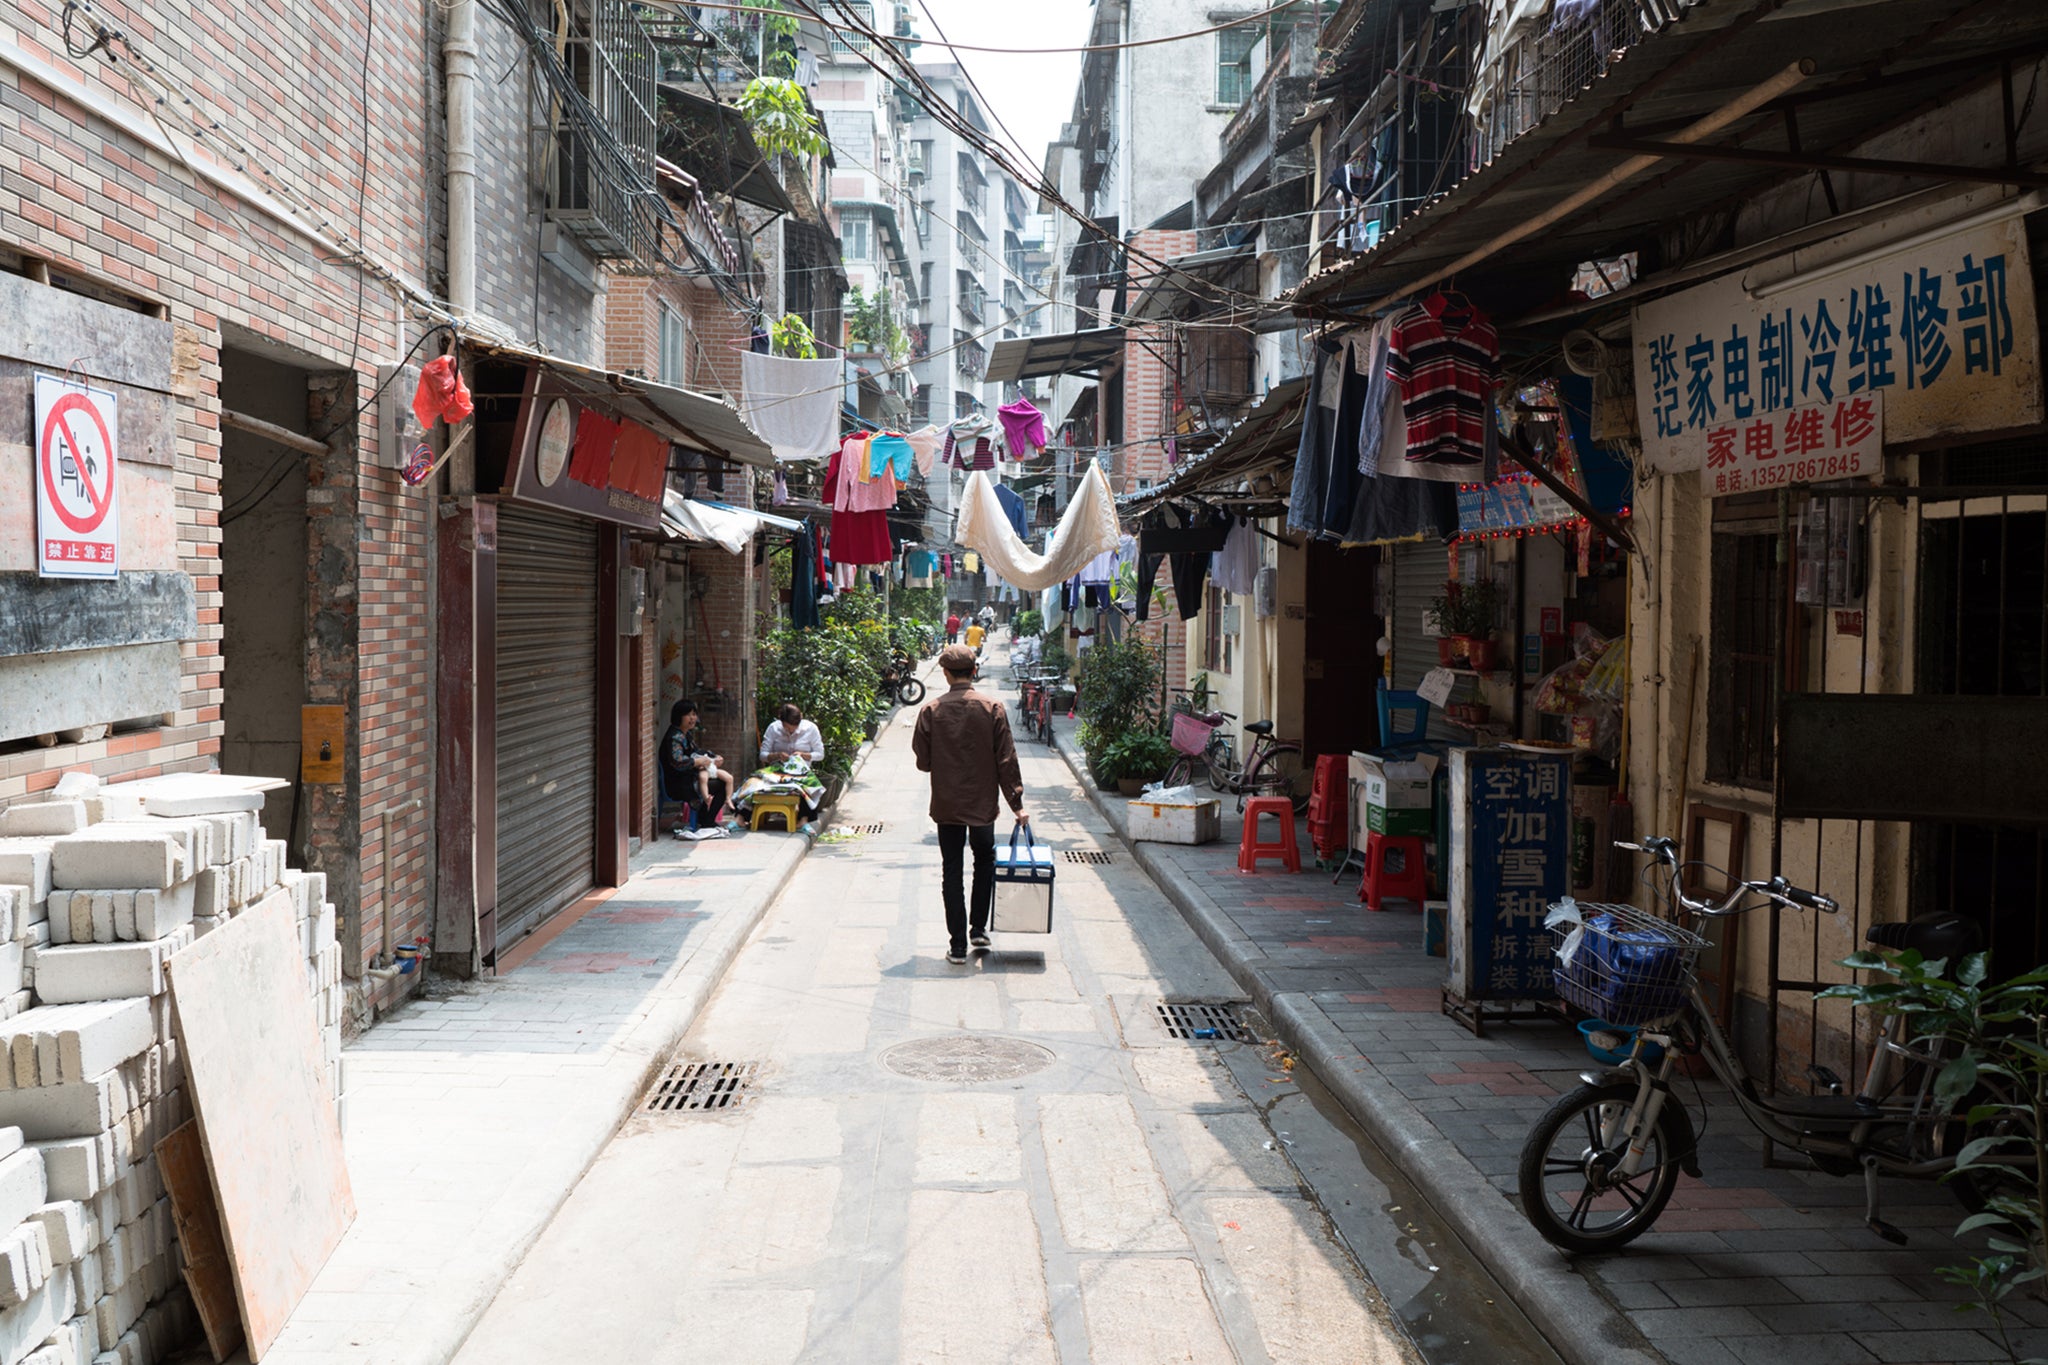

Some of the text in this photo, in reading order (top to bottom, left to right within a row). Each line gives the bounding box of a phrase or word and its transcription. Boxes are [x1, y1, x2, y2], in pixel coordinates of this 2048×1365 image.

[1707, 398, 1876, 469] 家电维修
[48, 542, 113, 561] 禁止靠近
